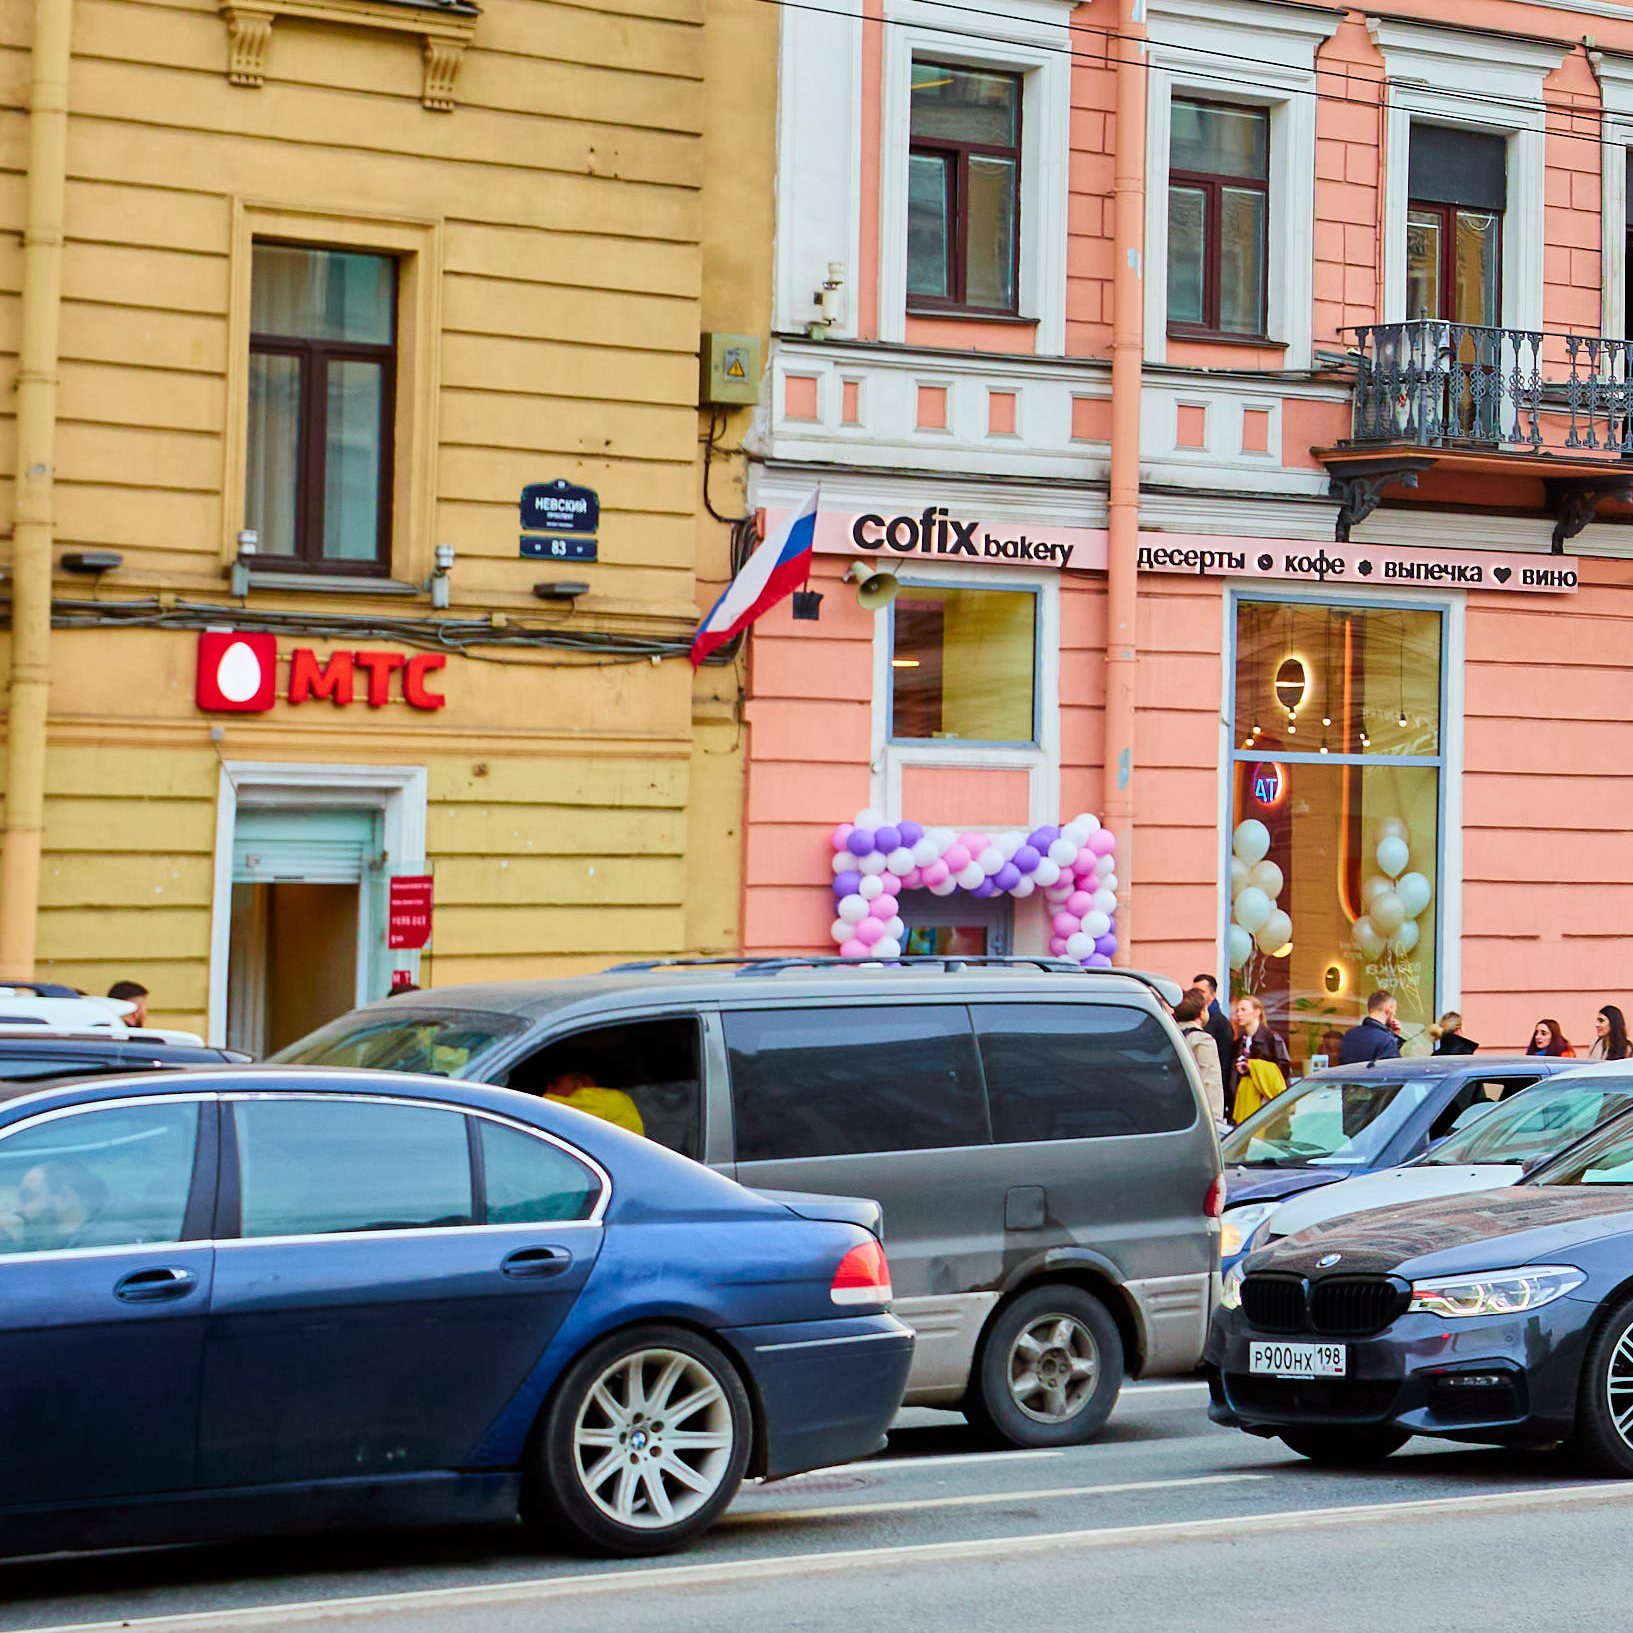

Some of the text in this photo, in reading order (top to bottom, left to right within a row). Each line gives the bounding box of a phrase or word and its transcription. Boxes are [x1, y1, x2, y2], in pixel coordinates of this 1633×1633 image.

[534, 496, 588, 514] НЕВСКИЙ
[551, 539, 567, 556] 83
[852, 506, 1075, 568] cofix bakery
[1137, 546, 1578, 587] десерты кофе выпечка вино
[287, 647, 447, 710] МТС
[1254, 1346, 1341, 1371] Р900НХ 198
